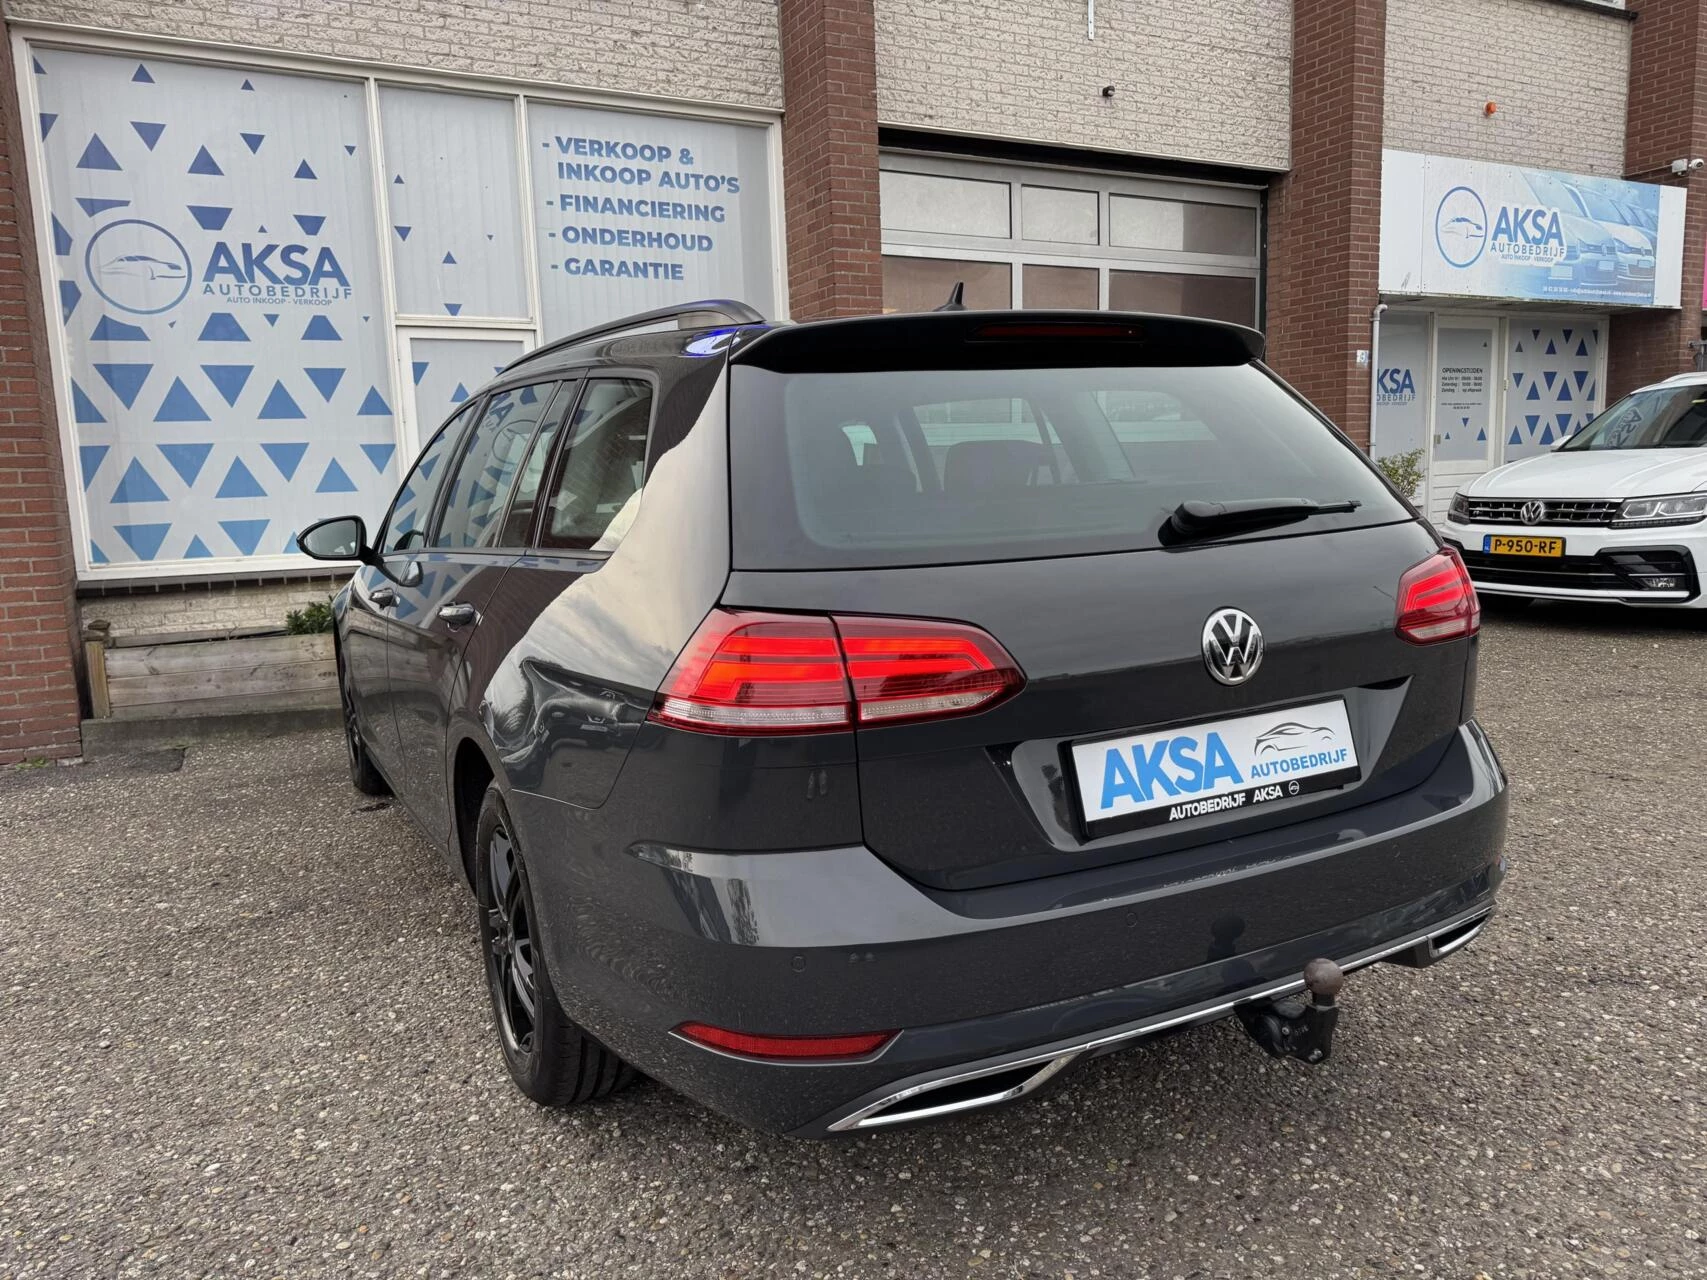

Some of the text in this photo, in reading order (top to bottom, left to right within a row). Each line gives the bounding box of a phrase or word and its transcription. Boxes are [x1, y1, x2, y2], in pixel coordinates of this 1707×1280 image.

[554, 136, 672, 163] VERKOOP
[678, 148, 694, 165] &
[557, 162, 651, 186] INKOOP
[559, 193, 726, 223] FINANCIERING
[562, 226, 713, 251] ONDERHOUD
[1491, 206, 1564, 247] AKSA
[1490, 242, 1565, 257] AUTOBEDRIJF
[202, 241, 351, 287] AKSA
[564, 257, 684, 281] GARANTIE
[203, 283, 352, 300] AUTOBEDRIJF
[226, 296, 251, 304] AUTO
[252, 297, 286, 305] INKOOP
[293, 298, 332, 306] VERKOOP
[1377, 368, 1416, 394] KSA
[1376, 394, 1416, 402] OBEDRIJF
[1494, 538, 1557, 554] P-950-RF
[1100, 732, 1347, 809] AKSA AUTOBEDRIJF
[1168, 786, 1283, 822] AUTOBEDRIJF AKSA
